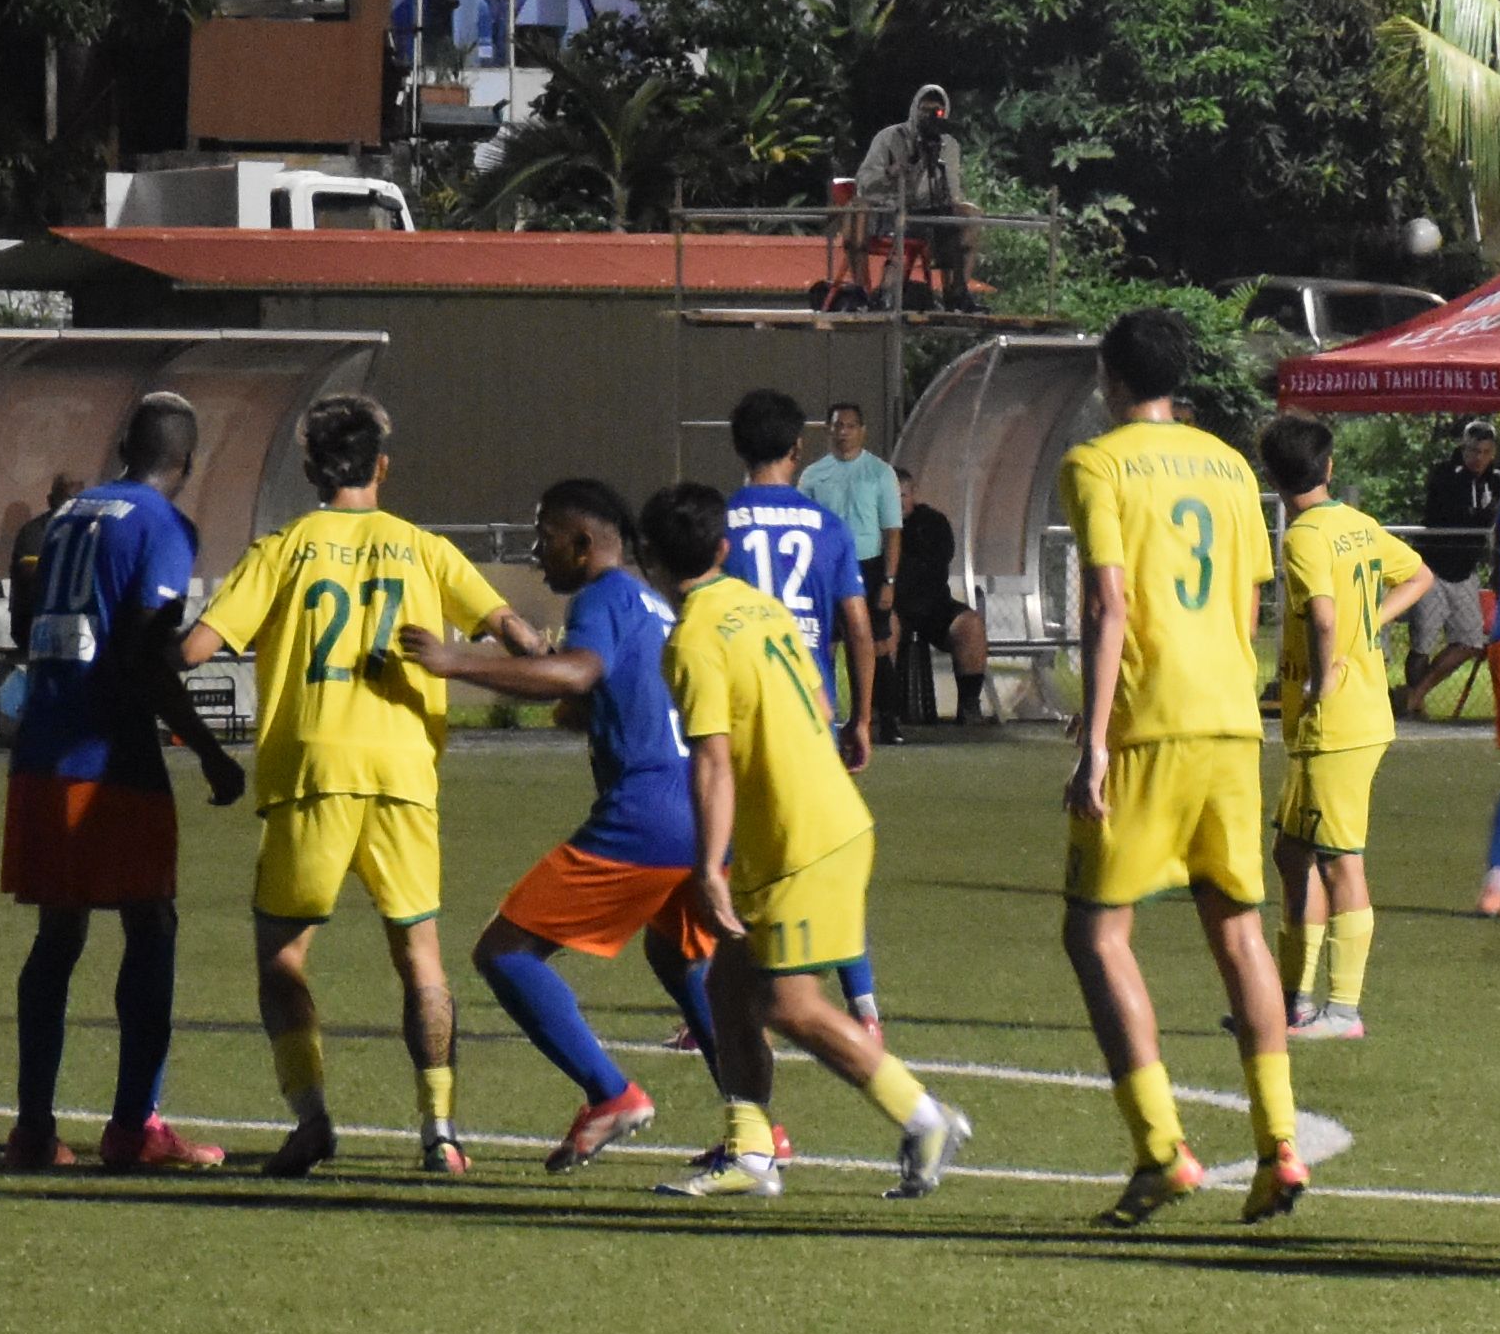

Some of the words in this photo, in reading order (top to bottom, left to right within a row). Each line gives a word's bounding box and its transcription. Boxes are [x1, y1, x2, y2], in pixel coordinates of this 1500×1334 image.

[1384, 369, 1474, 392] TAHITIENNE
[1480, 371, 1498, 391] DE
[325, 542, 415, 566] TEFANA
[742, 529, 814, 611] 12
[1171, 497, 1214, 611] 3
[304, 577, 405, 684] 27
